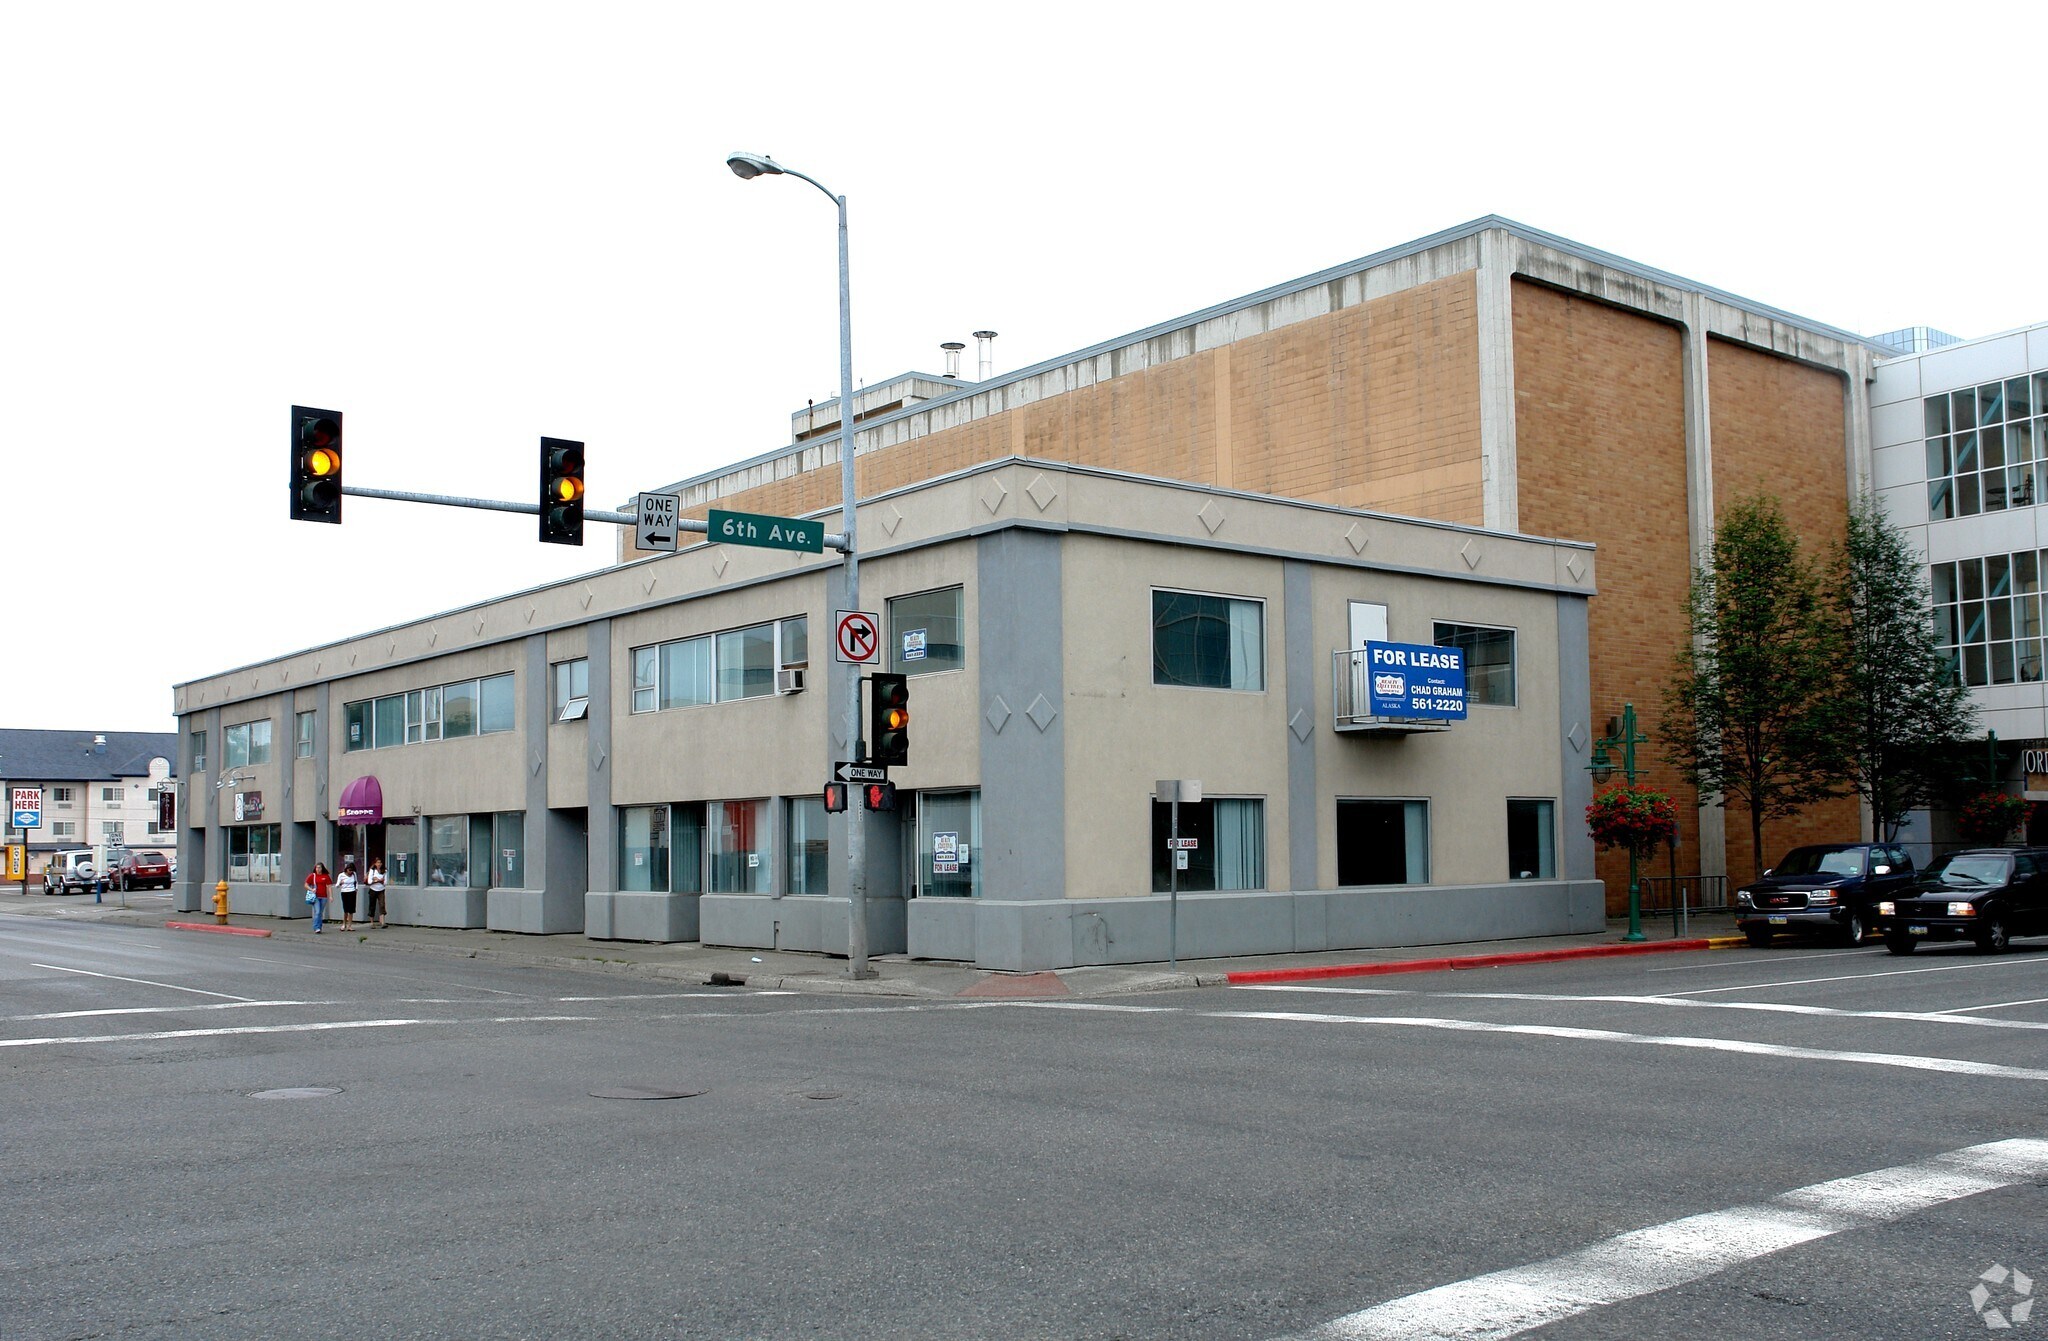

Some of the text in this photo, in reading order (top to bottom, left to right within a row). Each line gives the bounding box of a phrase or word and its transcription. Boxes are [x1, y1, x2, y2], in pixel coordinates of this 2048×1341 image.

[645, 498, 673, 512] ONE
[643, 513, 673, 527] WAY
[722, 518, 811, 544] 6th Ave.
[1373, 649, 1460, 669] FOR LEASE
[1411, 685, 1463, 696] CHAD GRAHAM
[1412, 698, 1463, 711] 561-2220
[851, 769, 882, 778] ONE WAY
[15, 790, 40, 800] PARK
[15, 800, 40, 810] HERE
[1169, 840, 1197, 848] FR LEASE
[934, 863, 958, 872] FOR LEASE
